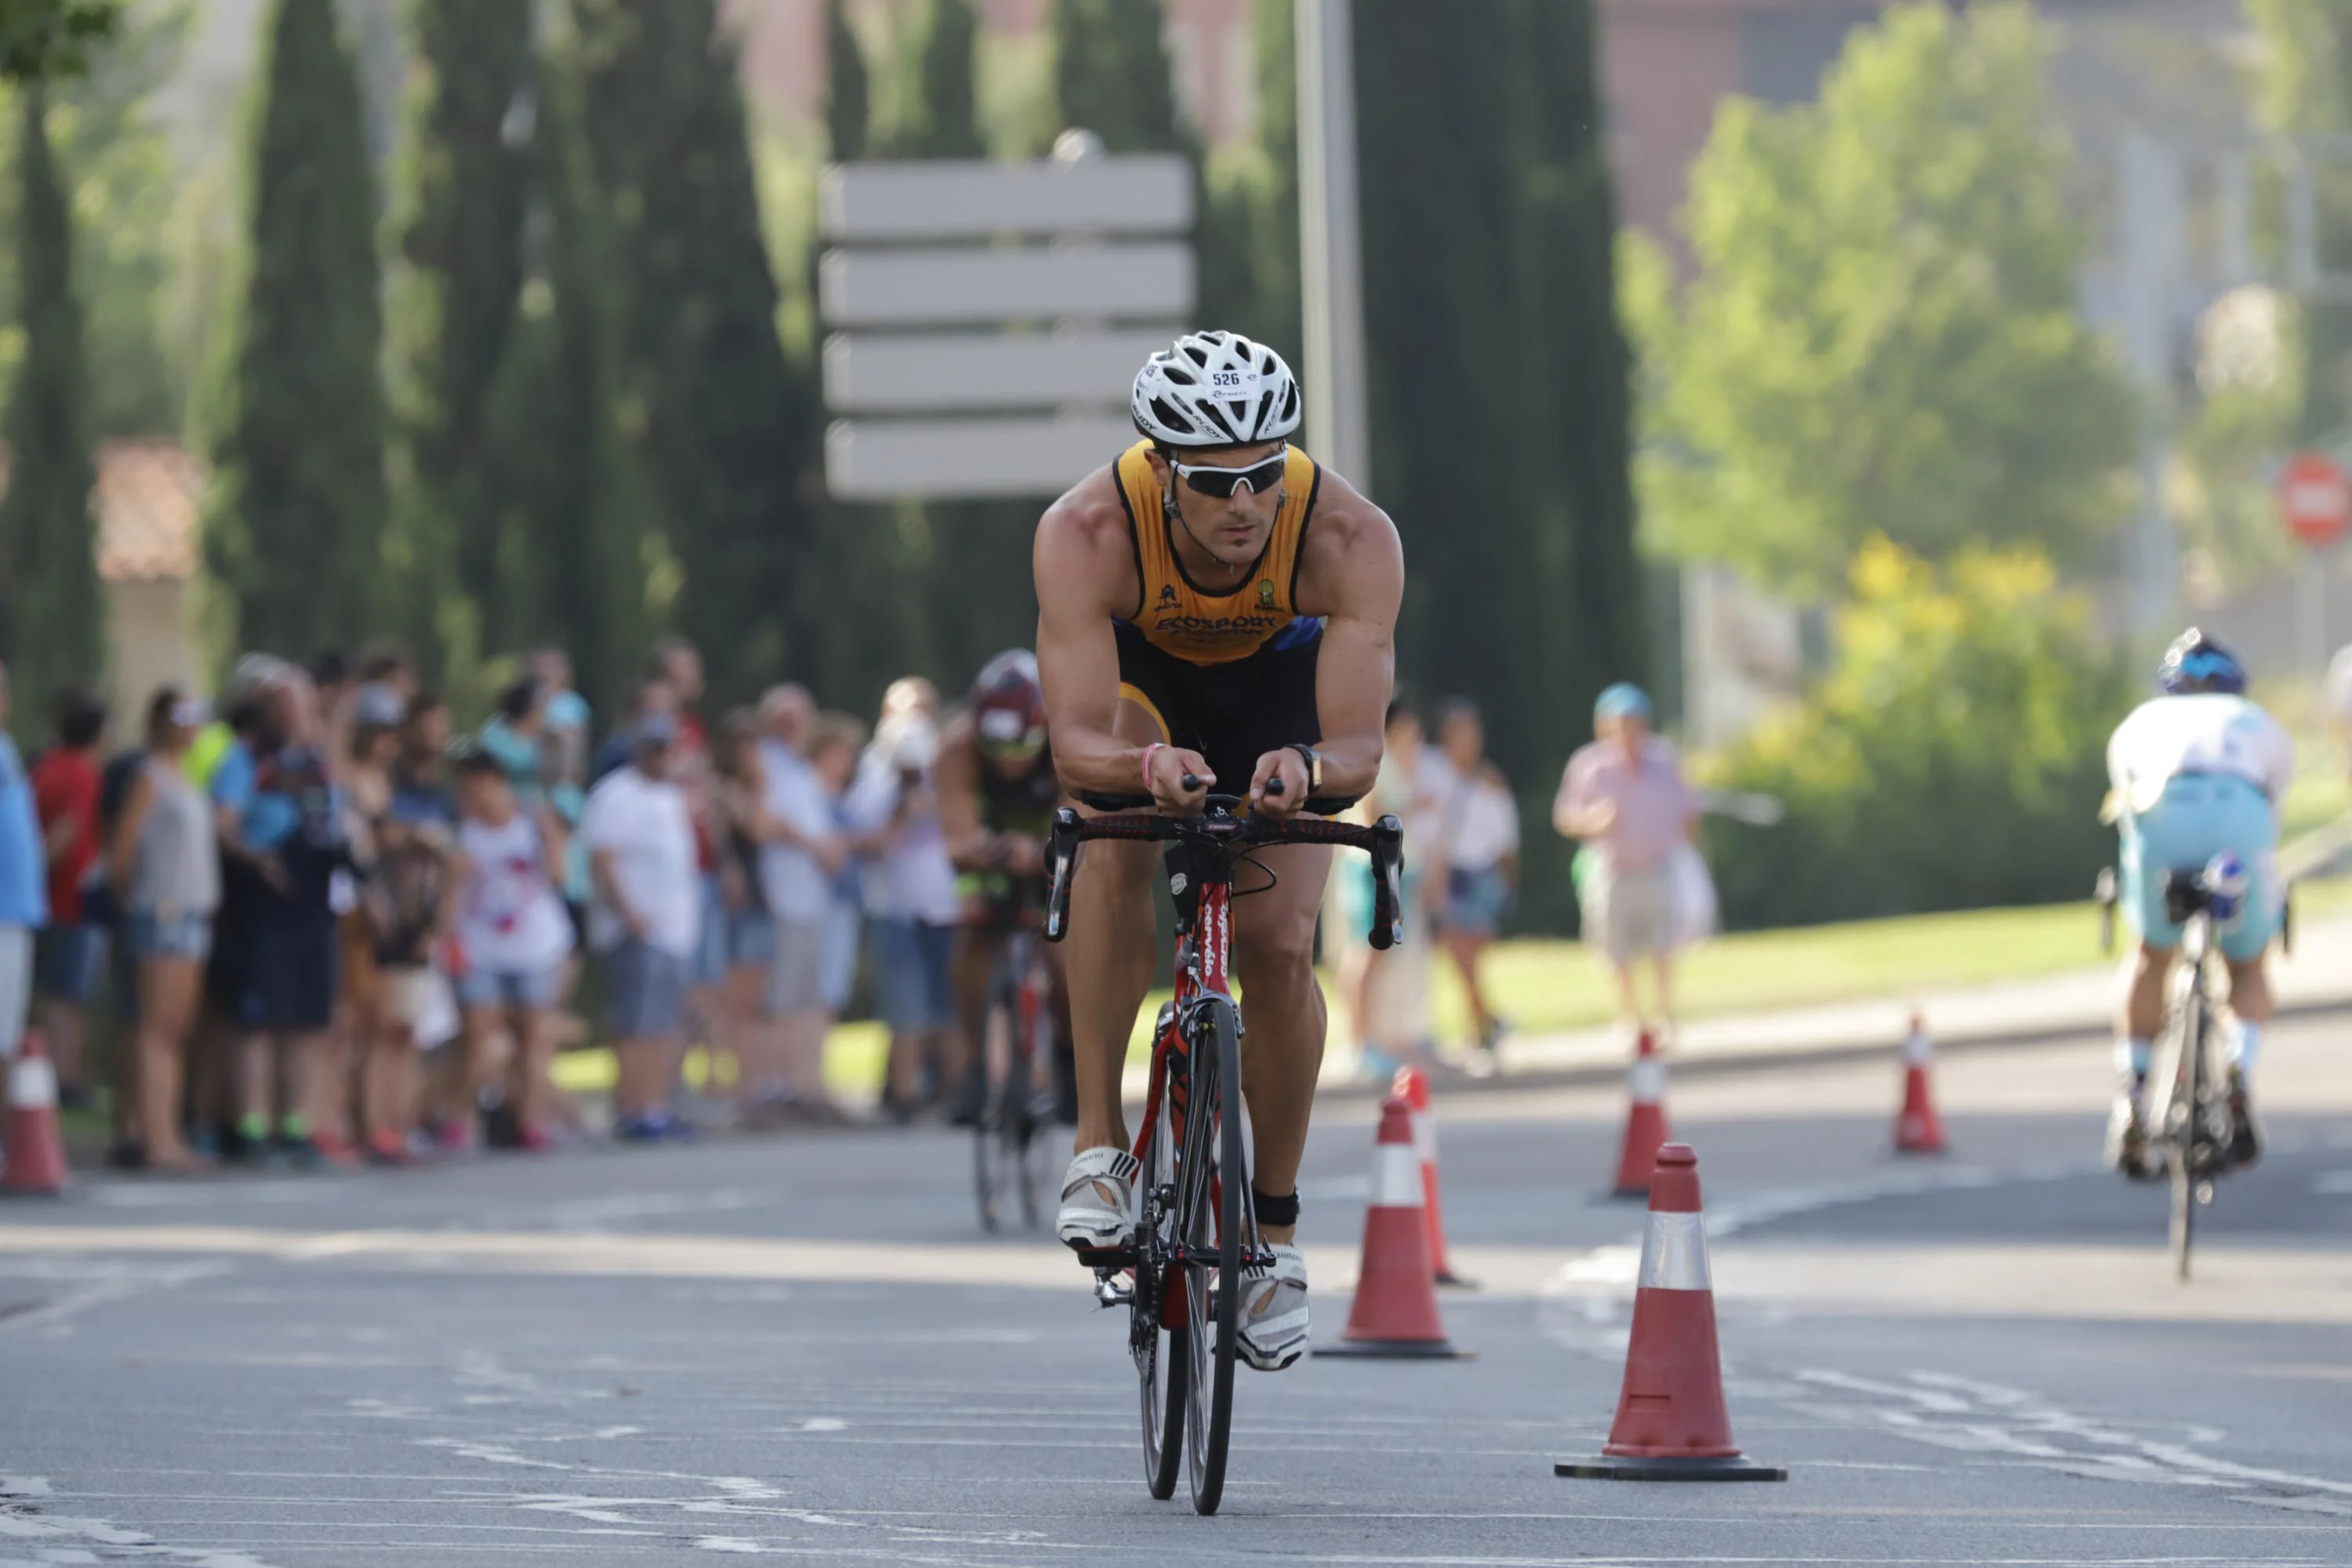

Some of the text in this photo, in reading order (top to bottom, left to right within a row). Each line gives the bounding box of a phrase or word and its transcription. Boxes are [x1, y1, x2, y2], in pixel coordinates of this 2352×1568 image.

[1213, 373, 1240, 386] 526
[1132, 404, 1157, 430] RUDY
[1192, 414, 1223, 440] RUDY
[1204, 903, 1215, 977] cervélo
